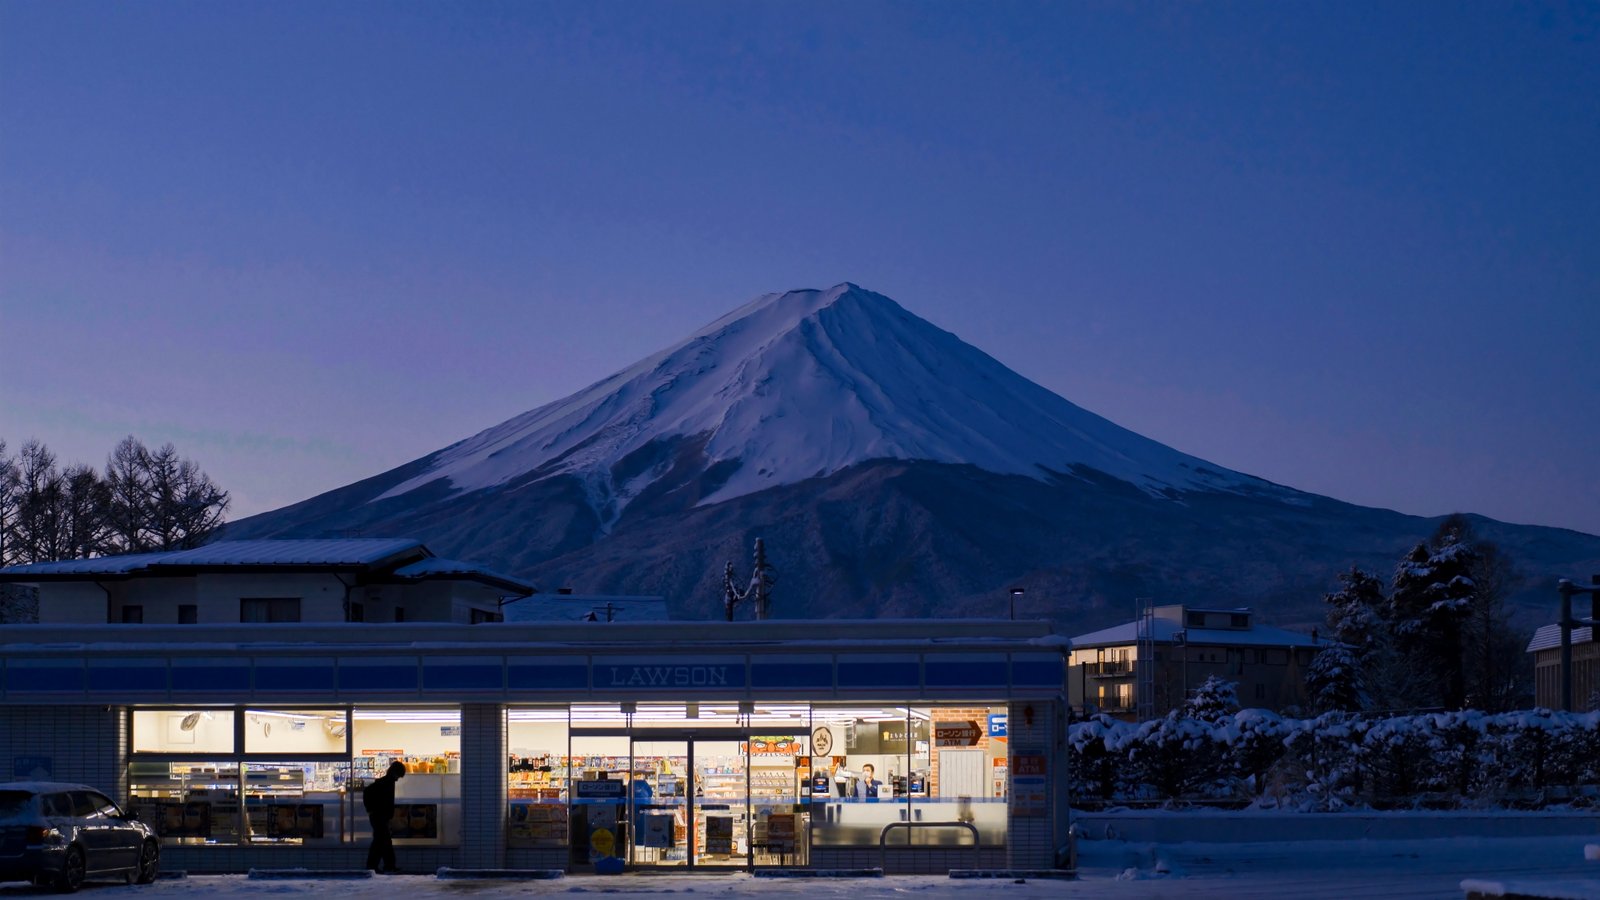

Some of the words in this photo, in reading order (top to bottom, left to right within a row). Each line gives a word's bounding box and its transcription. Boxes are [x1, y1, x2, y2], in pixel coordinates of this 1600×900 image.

[610, 667, 727, 685] LAWSON
[937, 729, 976, 737] ローソン銀行
[1018, 765, 1040, 774] ATM
